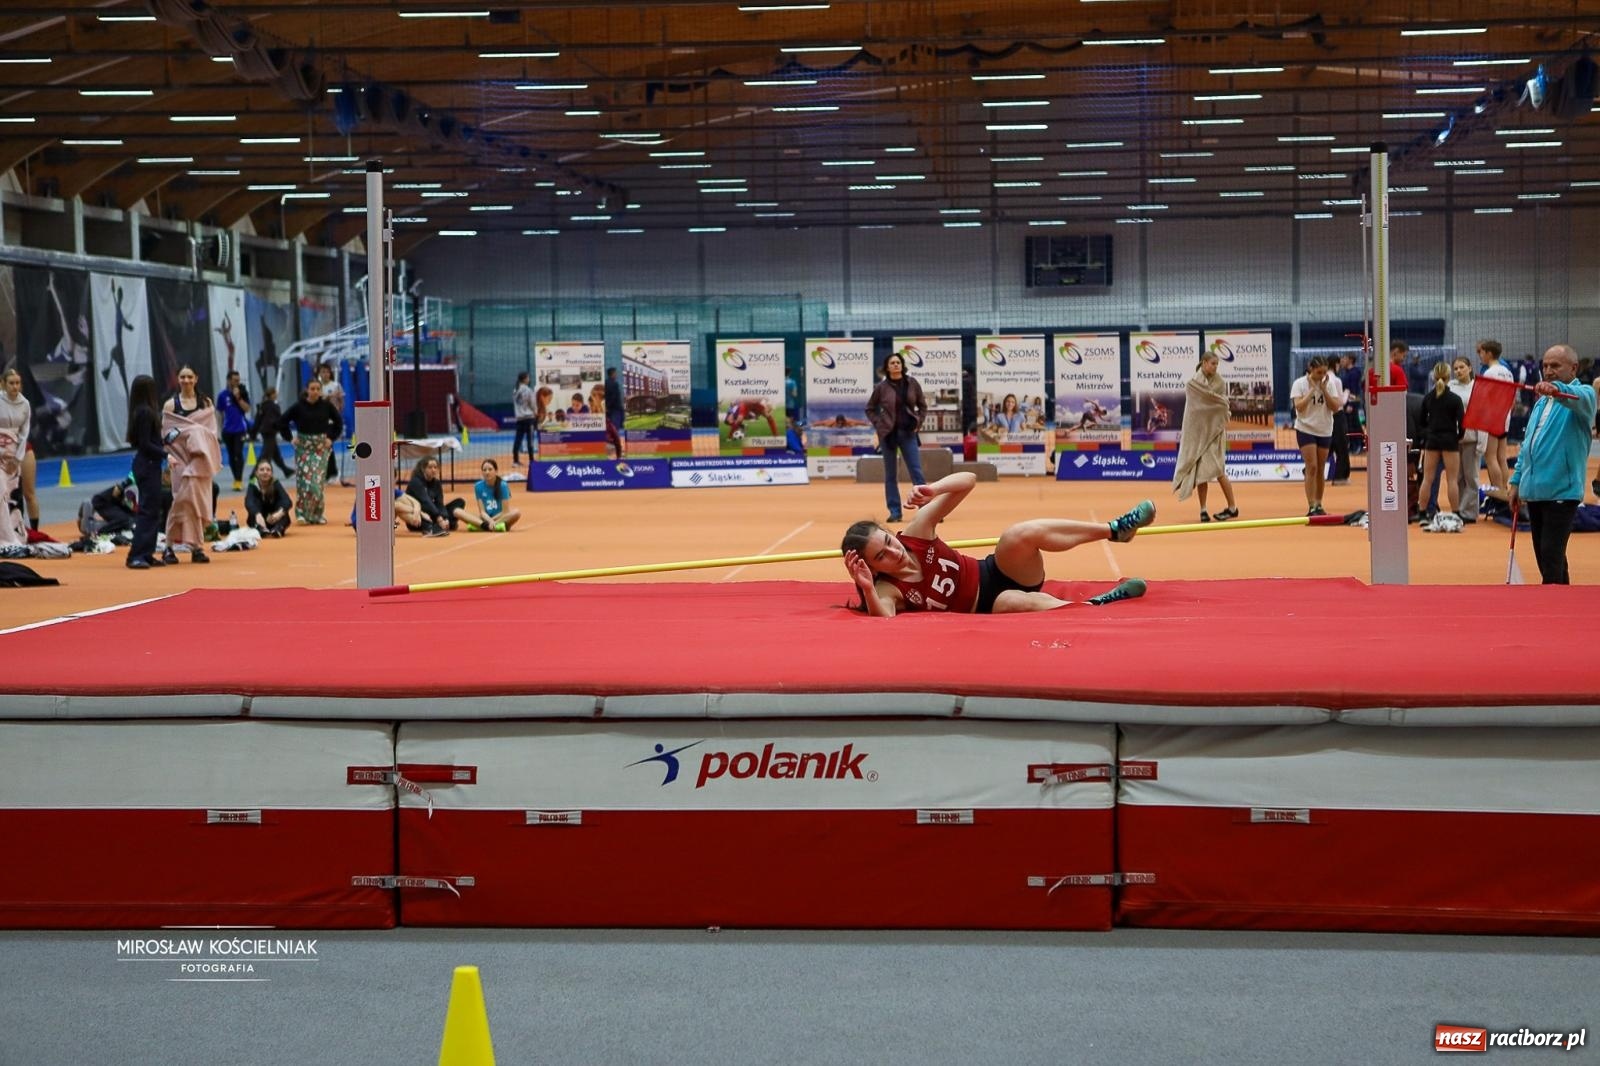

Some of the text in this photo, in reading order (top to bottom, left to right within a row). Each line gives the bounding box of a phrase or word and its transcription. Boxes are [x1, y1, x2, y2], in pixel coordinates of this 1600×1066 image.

[1084, 348, 1115, 357] ZSOMS
[1162, 346, 1194, 355] ZSOMS
[1236, 344, 1267, 353] ZSOMS
[748, 353, 780, 362] ZSOMS
[837, 352, 869, 361] ZSOMS
[925, 351, 957, 360] ZSOMS
[1008, 349, 1040, 358] ZSOMS
[1061, 372, 1104, 381] Kształcimy
[1137, 371, 1183, 380] Kształcimy
[724, 378, 769, 387] Kształcimy
[813, 377, 857, 386] Kształcimy
[1076, 381, 1114, 390] Mistrzów
[1153, 380, 1185, 389] Mistrzó
[740, 387, 778, 395] Mistrzów
[829, 386, 867, 395] Mistrzów
[1092, 454, 1128, 467] Śląskie.
[566, 464, 605, 477] Śląskie.
[369, 490, 378, 520] polanik
[925, 557, 960, 611] 151
[695, 743, 869, 789] polanik
